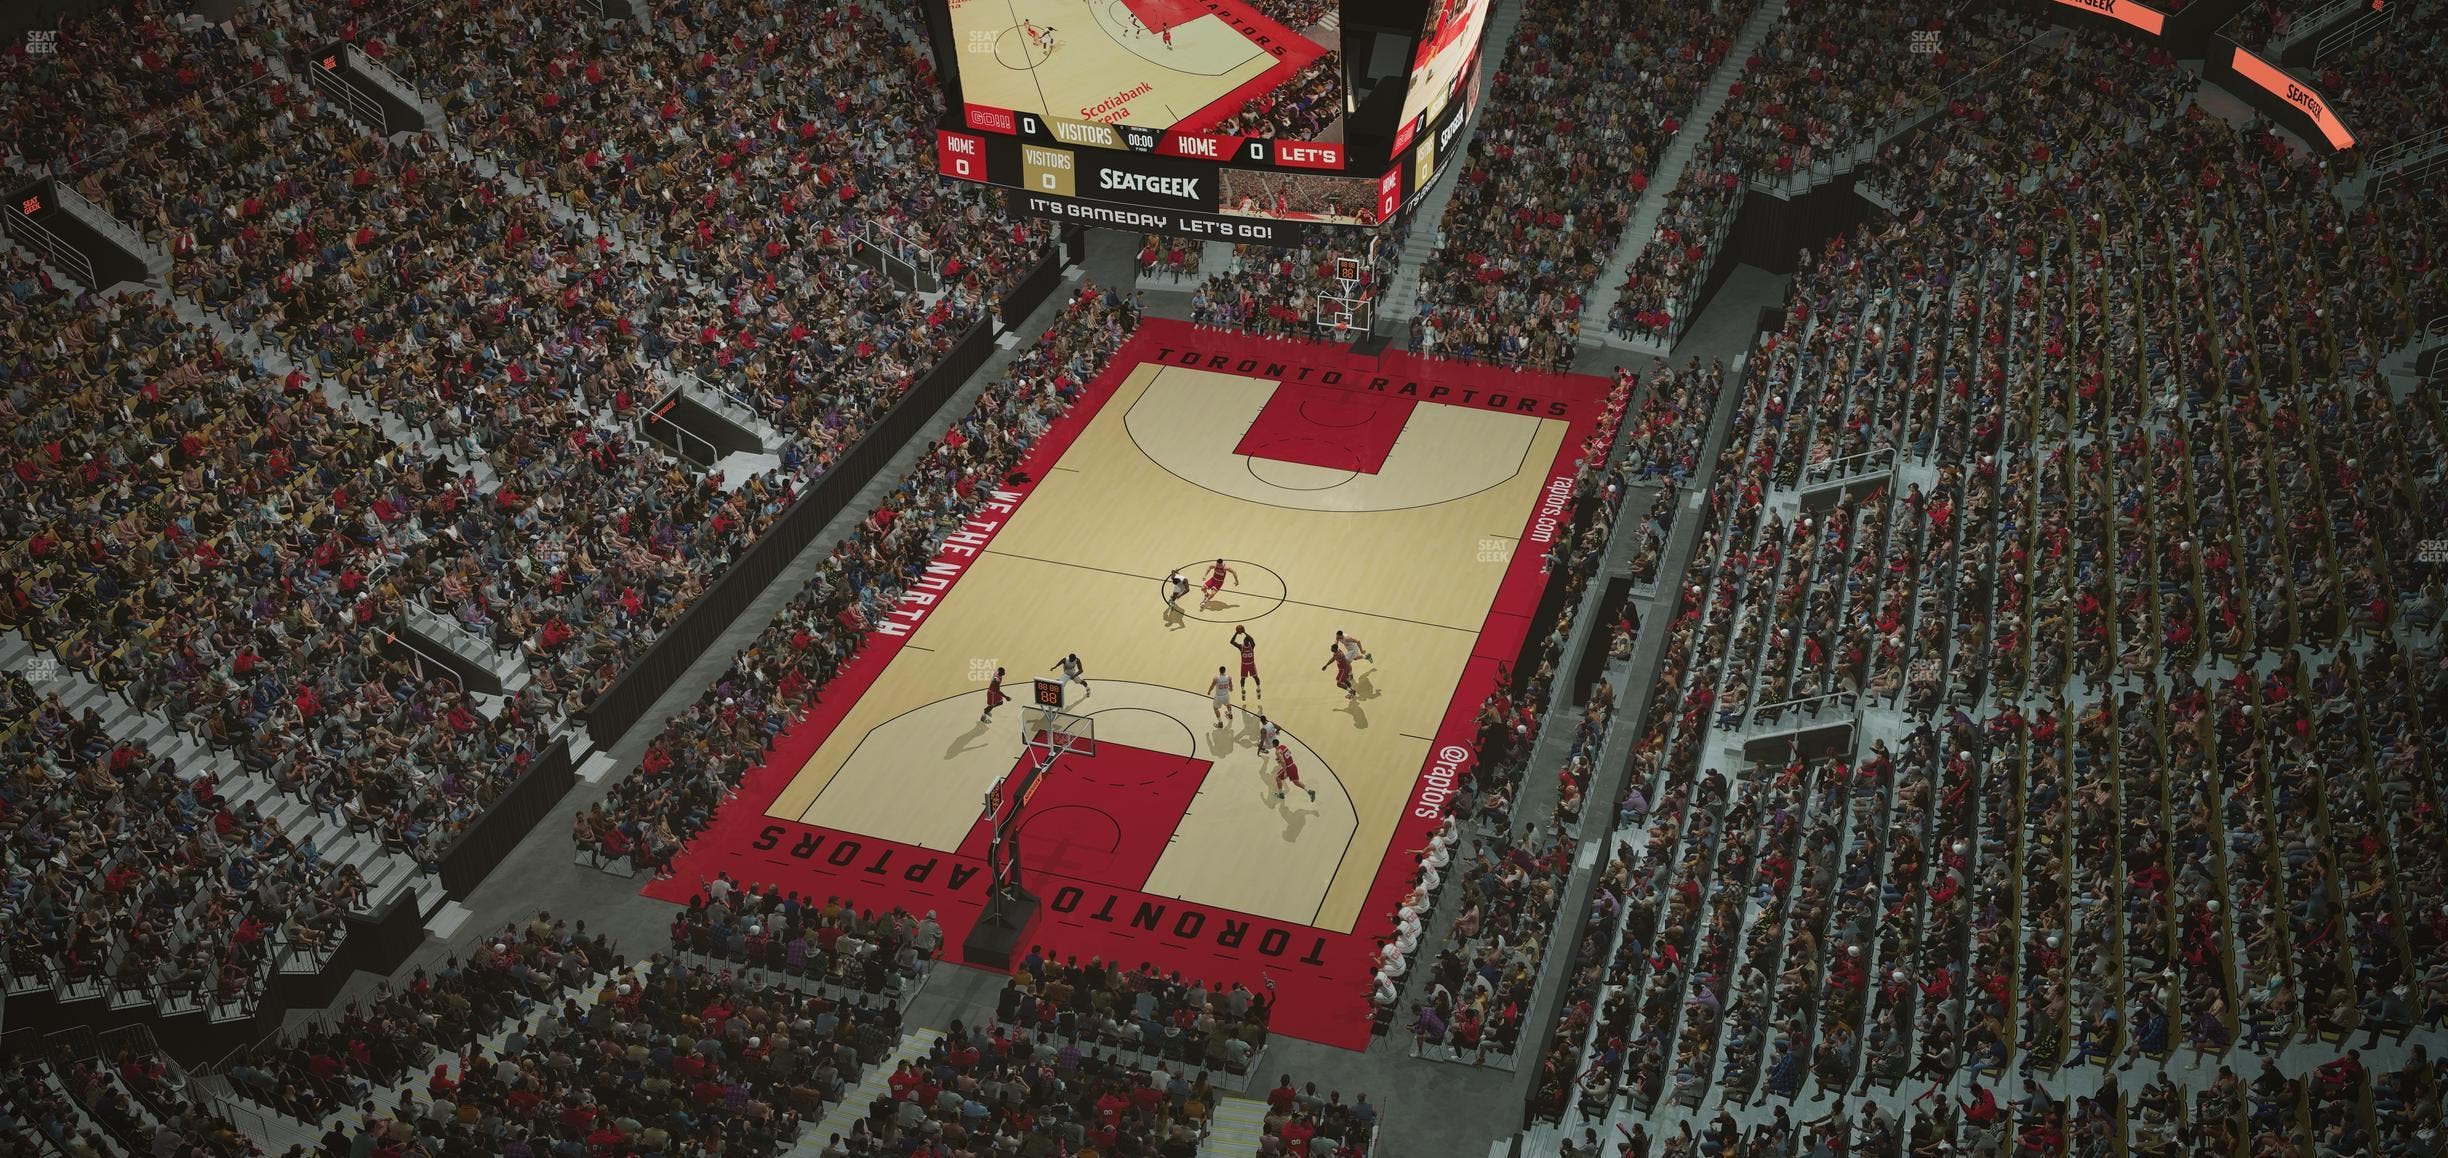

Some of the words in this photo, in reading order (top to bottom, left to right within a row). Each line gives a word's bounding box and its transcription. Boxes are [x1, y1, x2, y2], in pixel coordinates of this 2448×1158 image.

[1206, 2, 1288, 56] APTORS
[1081, 81, 1153, 122] Scotiabank
[2286, 83, 2323, 122] SEATGEEK
[971, 111, 1011, 129] GO!!!
[1023, 117, 1036, 134] 0
[947, 136, 975, 155] HOME
[1056, 121, 1112, 146] VISITORS
[1128, 133, 1153, 148] 00:00
[1178, 136, 1218, 157] HOME
[1250, 143, 1264, 160] 0
[1282, 146, 1337, 163] LET'S
[956, 159, 970, 175] 0
[1025, 150, 1071, 170] VISITORS
[1042, 173, 1056, 189] 0
[1100, 168, 1200, 200] SEATGEEK
[1030, 198, 1063, 215] IT'S
[1067, 203, 1168, 229] GAMEDAY
[1180, 218, 1234, 236] LET'S
[1238, 224, 1273, 239] GO!
[1156, 348, 1343, 386] TORONTO
[1368, 377, 1569, 416] RAPTORS
[990, 490, 1023, 514] WE
[1531, 476, 1574, 543] raptors.com
[940, 520, 999, 557] THE
[878, 561, 962, 637] NORTH
[1041, 690, 1057, 704] 88
[1414, 745, 1469, 819] @raptors
[1050, 886, 1327, 967] TORONTO
